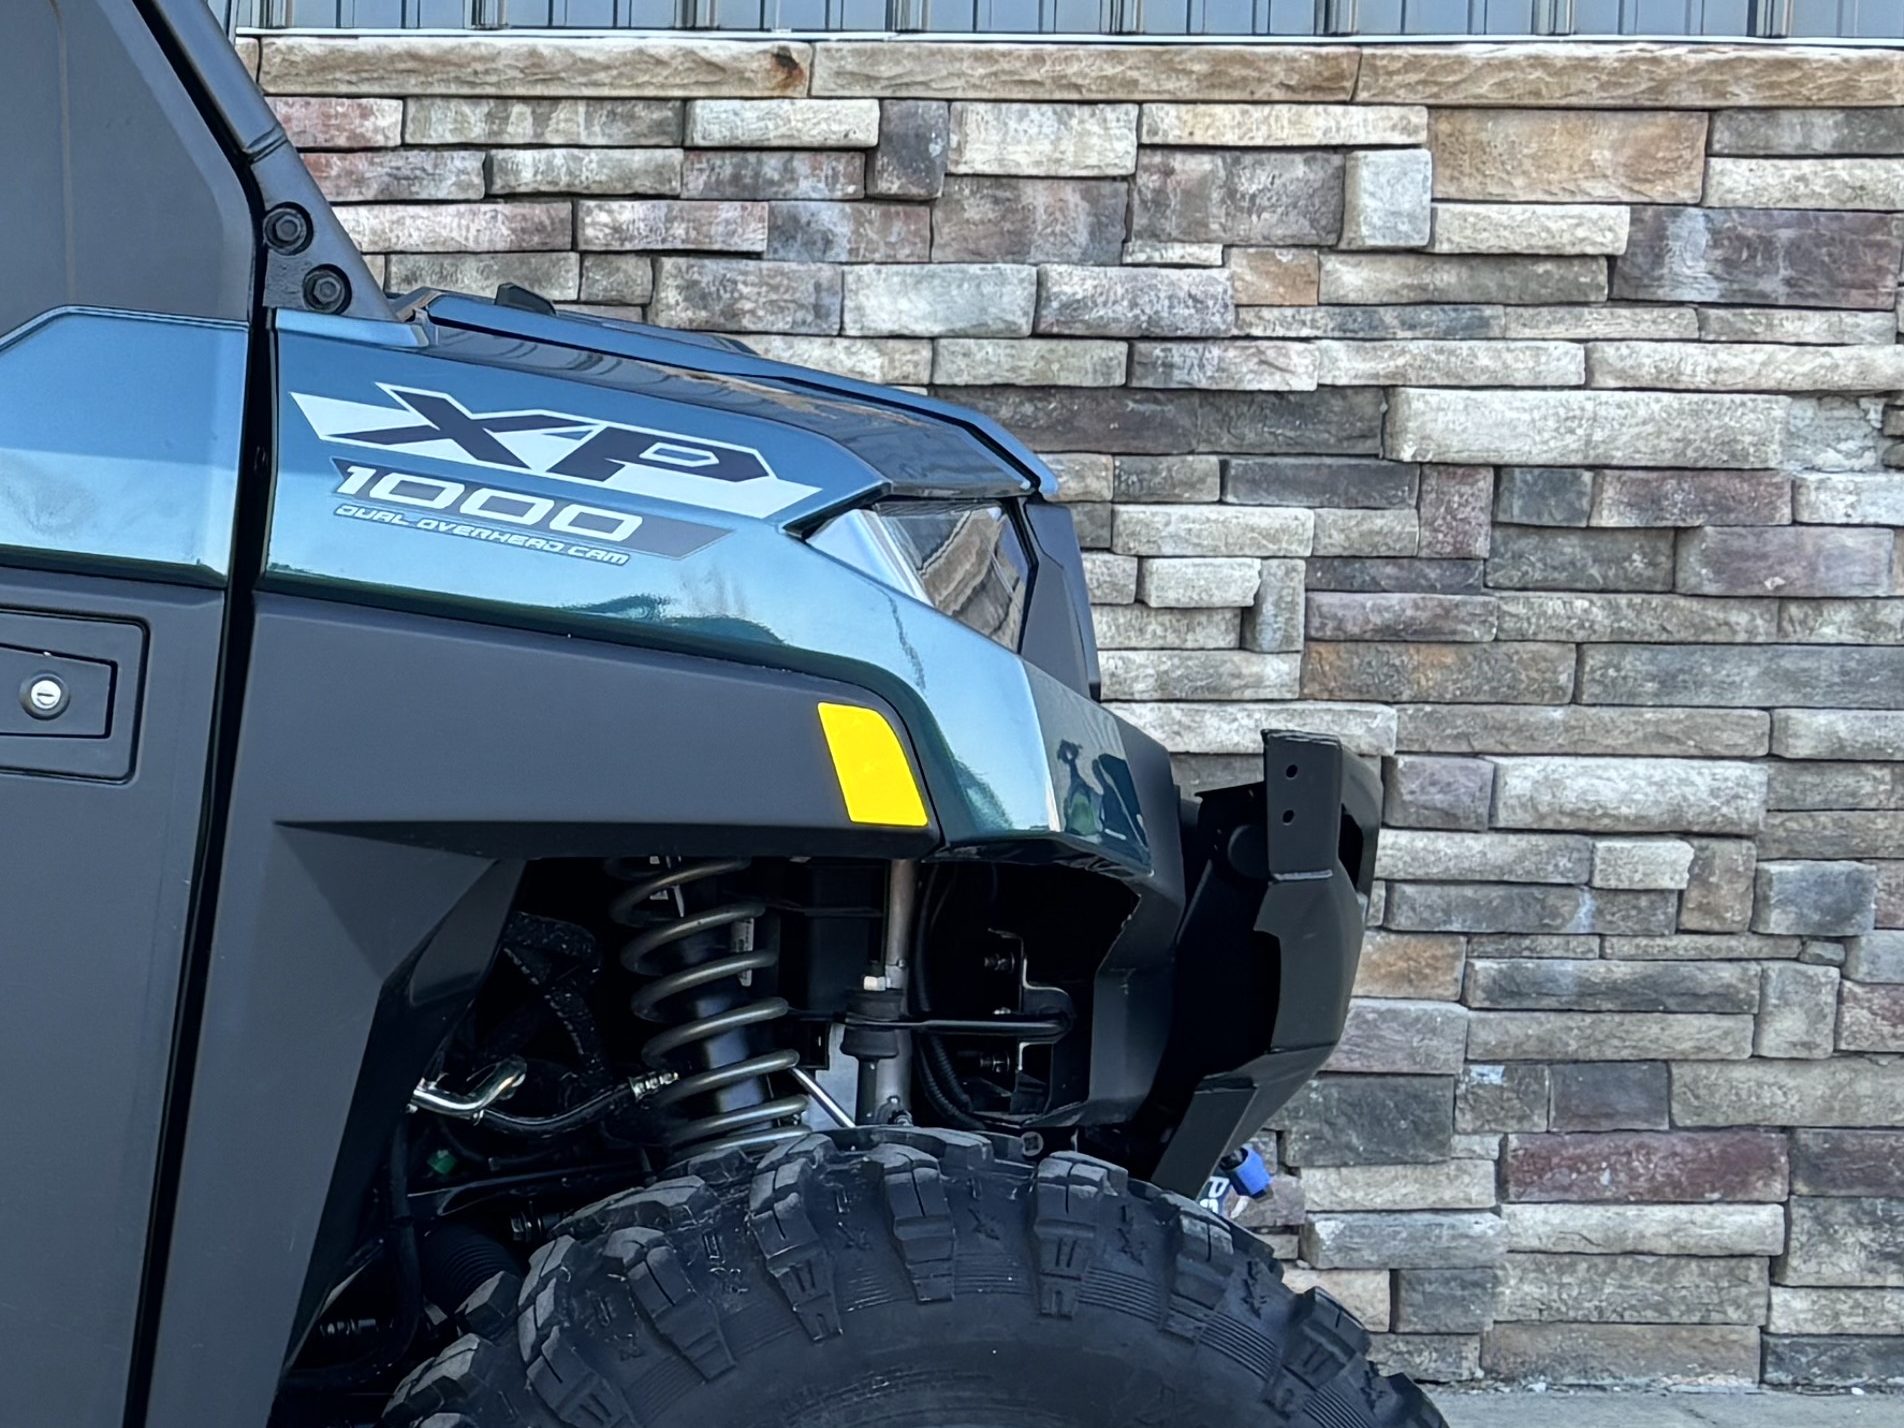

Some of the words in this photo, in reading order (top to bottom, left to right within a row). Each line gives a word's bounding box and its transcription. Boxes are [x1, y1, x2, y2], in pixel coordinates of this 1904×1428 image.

[323, 388, 773, 483] XP
[335, 504, 409, 527] DUAL
[416, 517, 566, 553] OVERHEAD
[567, 545, 631, 565] CAM
[336, 465, 643, 542] 1000
